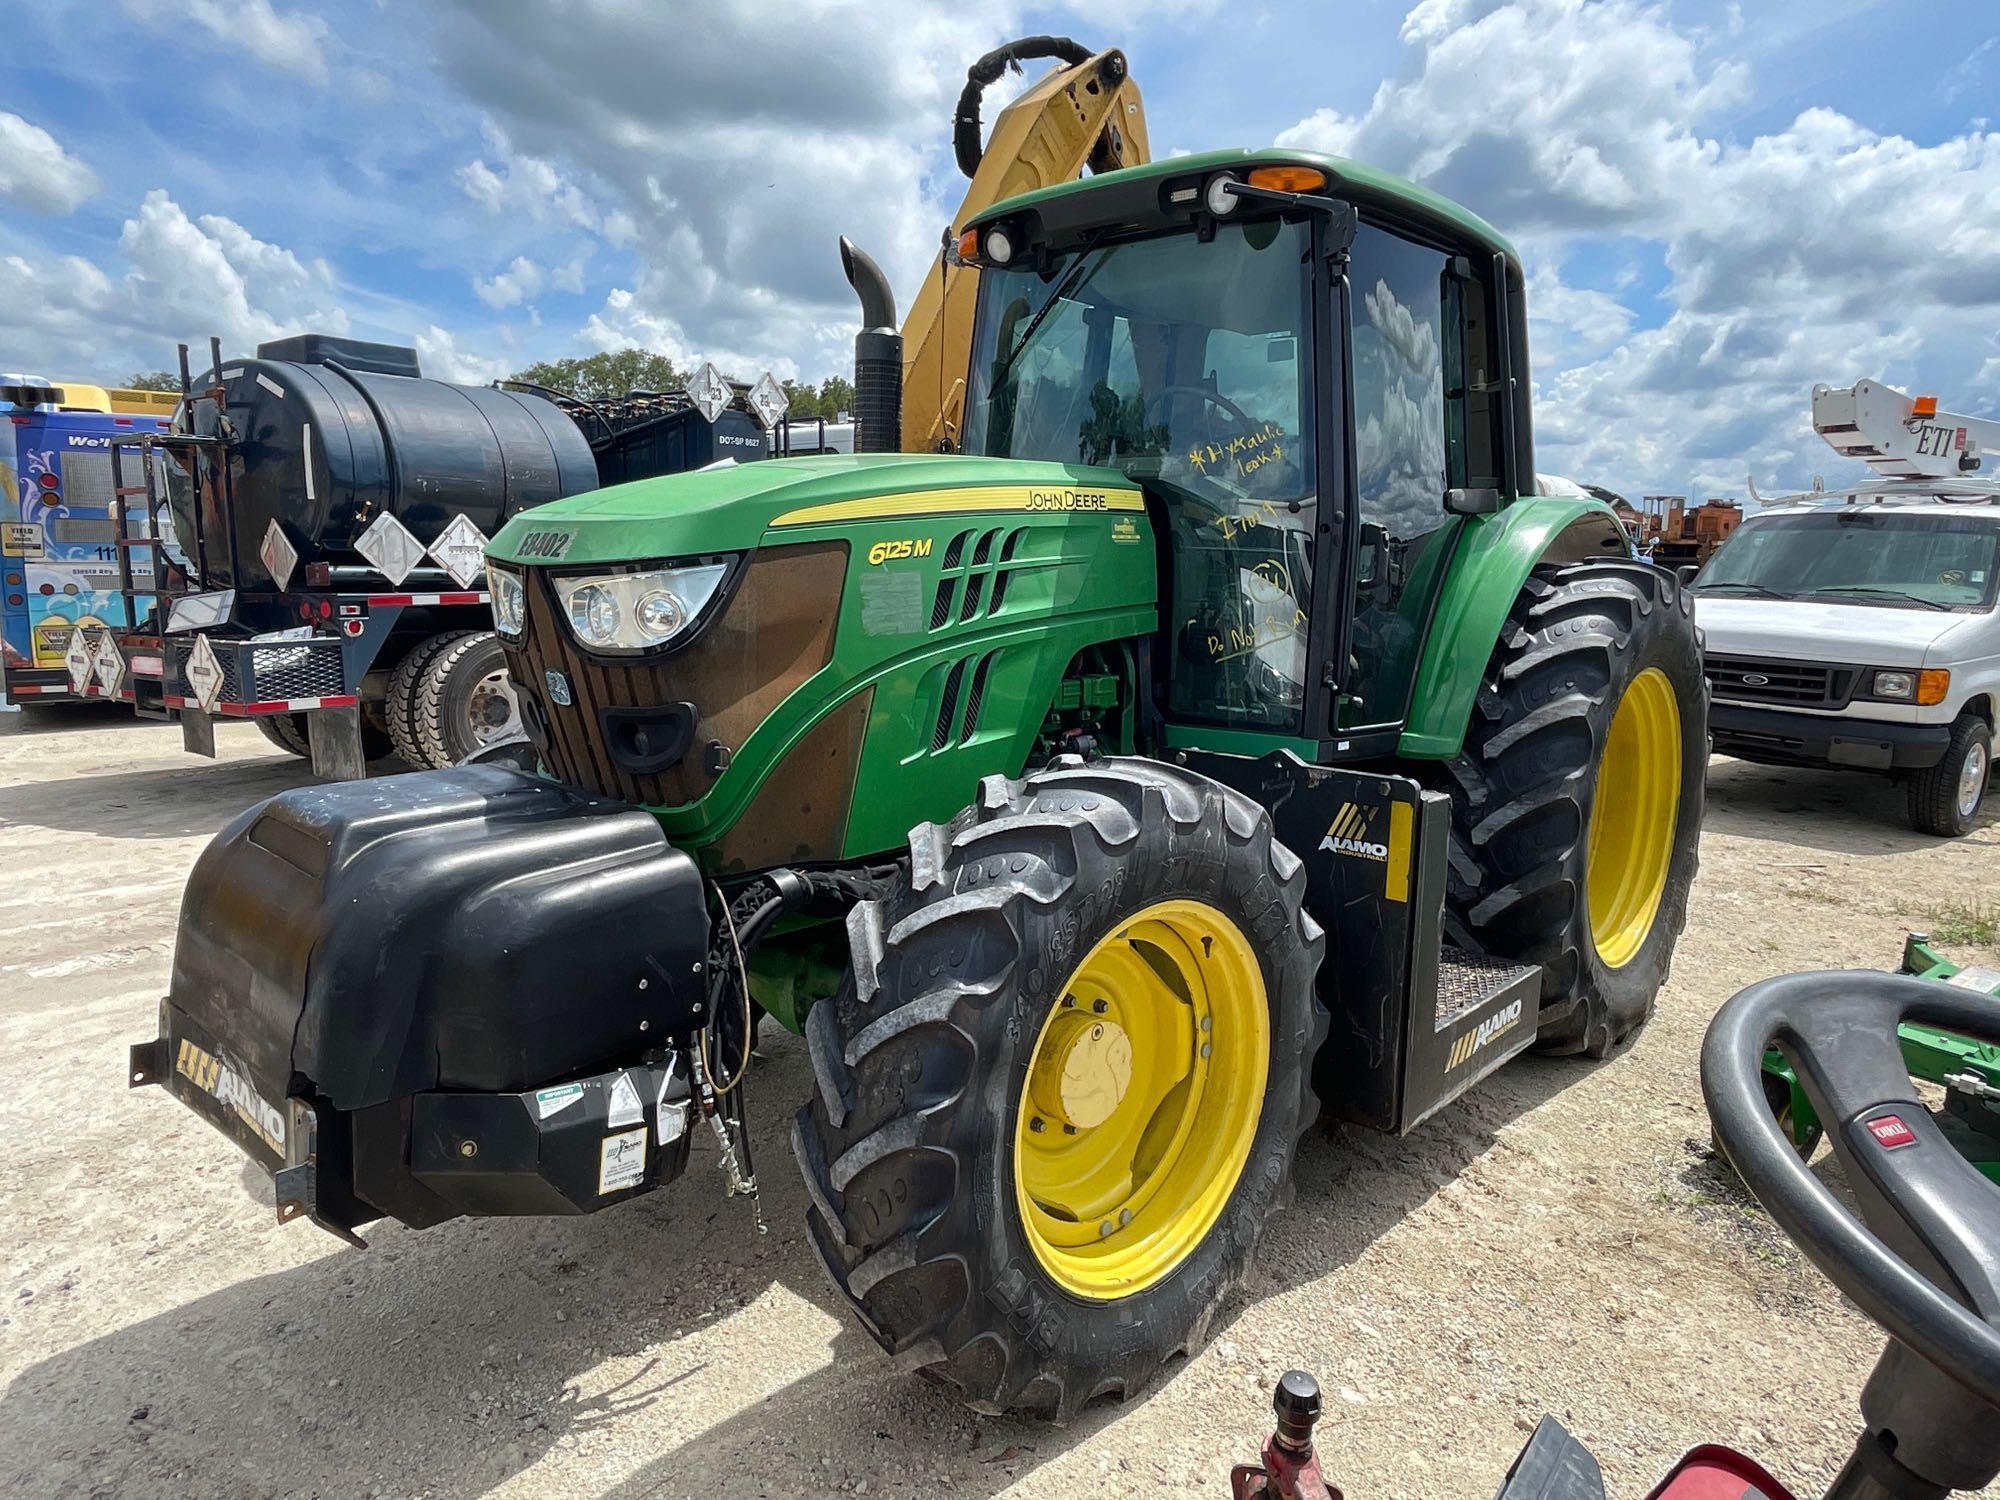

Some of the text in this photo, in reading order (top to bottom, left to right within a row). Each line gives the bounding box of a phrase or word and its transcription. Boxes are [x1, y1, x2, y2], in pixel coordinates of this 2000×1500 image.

[719, 435, 744, 446] DOT-SP
[1915, 425, 1955, 457] ETI
[1026, 490, 1108, 510] JOHN DEERE
[517, 532, 570, 558] E8402
[1208, 608, 1308, 655] Do Not Run
[1318, 835, 1388, 857] ALAMO
[1472, 999, 1522, 1055] ALAMO
[216, 1064, 286, 1144] ALAMO
[544, 1086, 574, 1100] IMPORTANT
